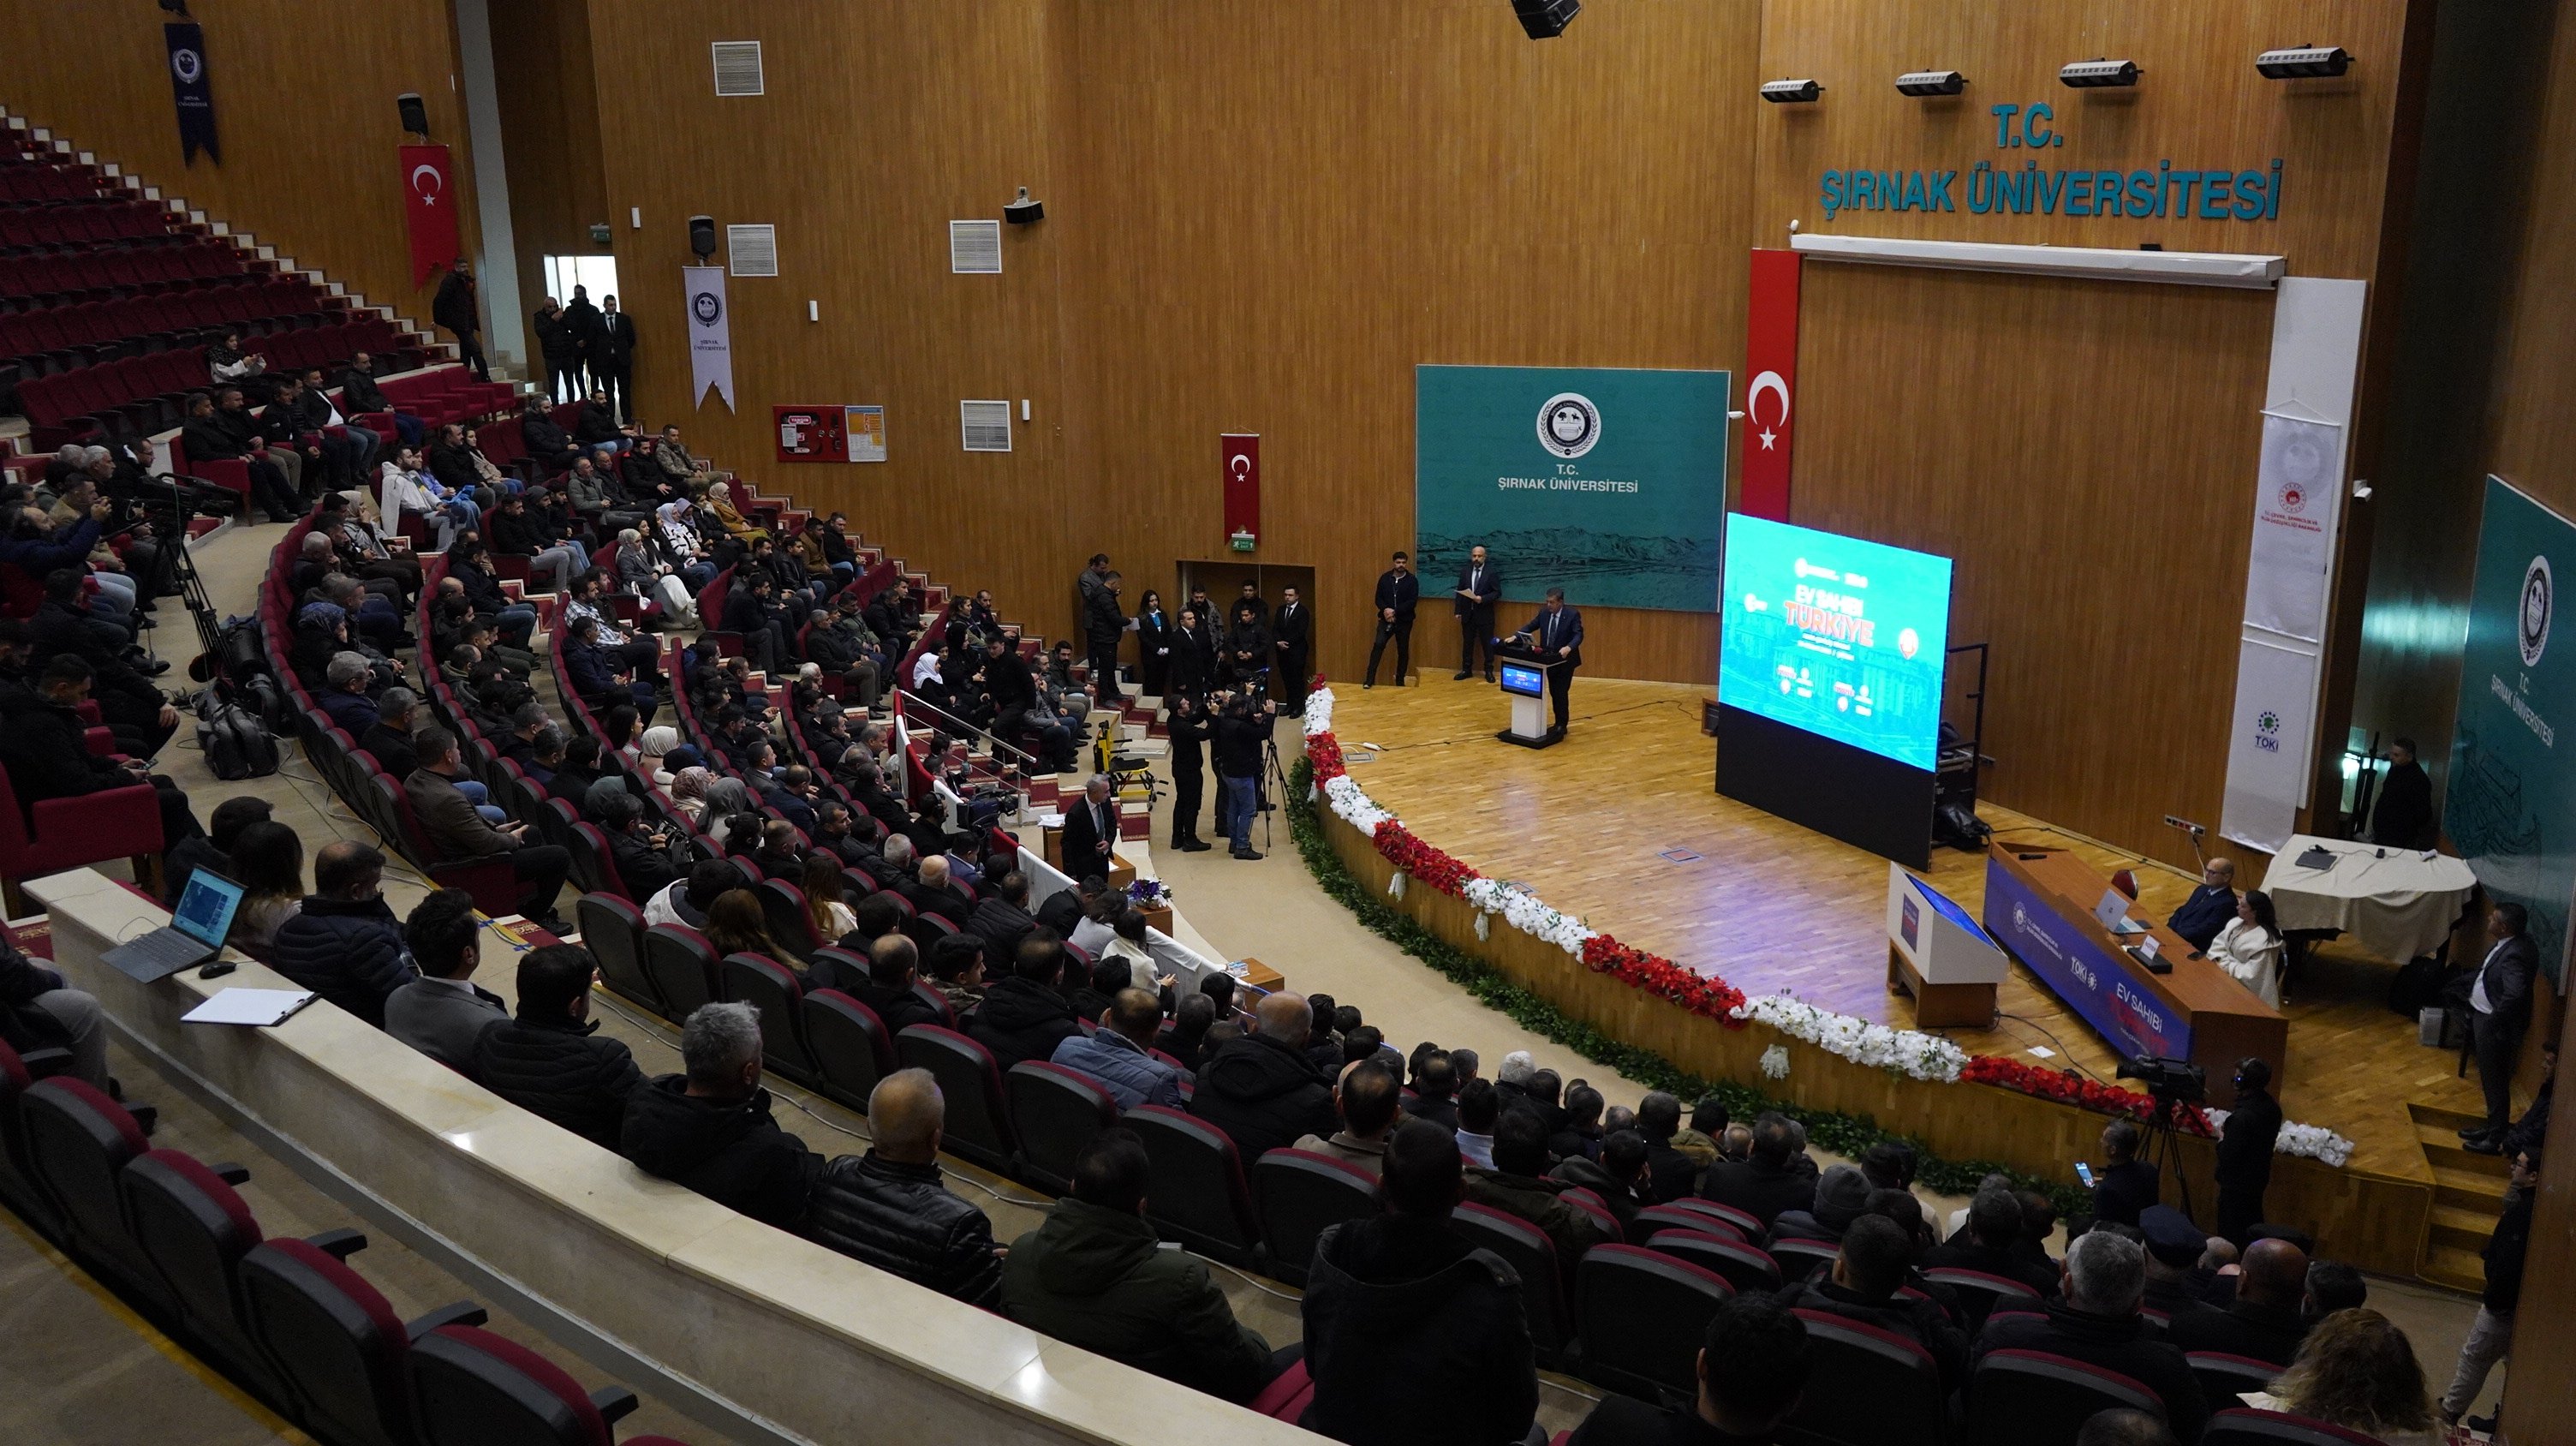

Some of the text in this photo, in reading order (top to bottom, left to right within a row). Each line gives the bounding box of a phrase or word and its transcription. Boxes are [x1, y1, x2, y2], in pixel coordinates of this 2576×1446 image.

[1991, 101, 2064, 147] T.C.
[1821, 158, 2284, 220] ŞIRNAK ÜNİVERSİTESİ
[1498, 477, 1638, 493] ŞIRNAK ÜNİVERSİTESİ
[1556, 463, 1579, 475] T.C.
[2512, 690, 2555, 749] ÜNİVERSİTESİ
[2116, 982, 2131, 1003] EV
